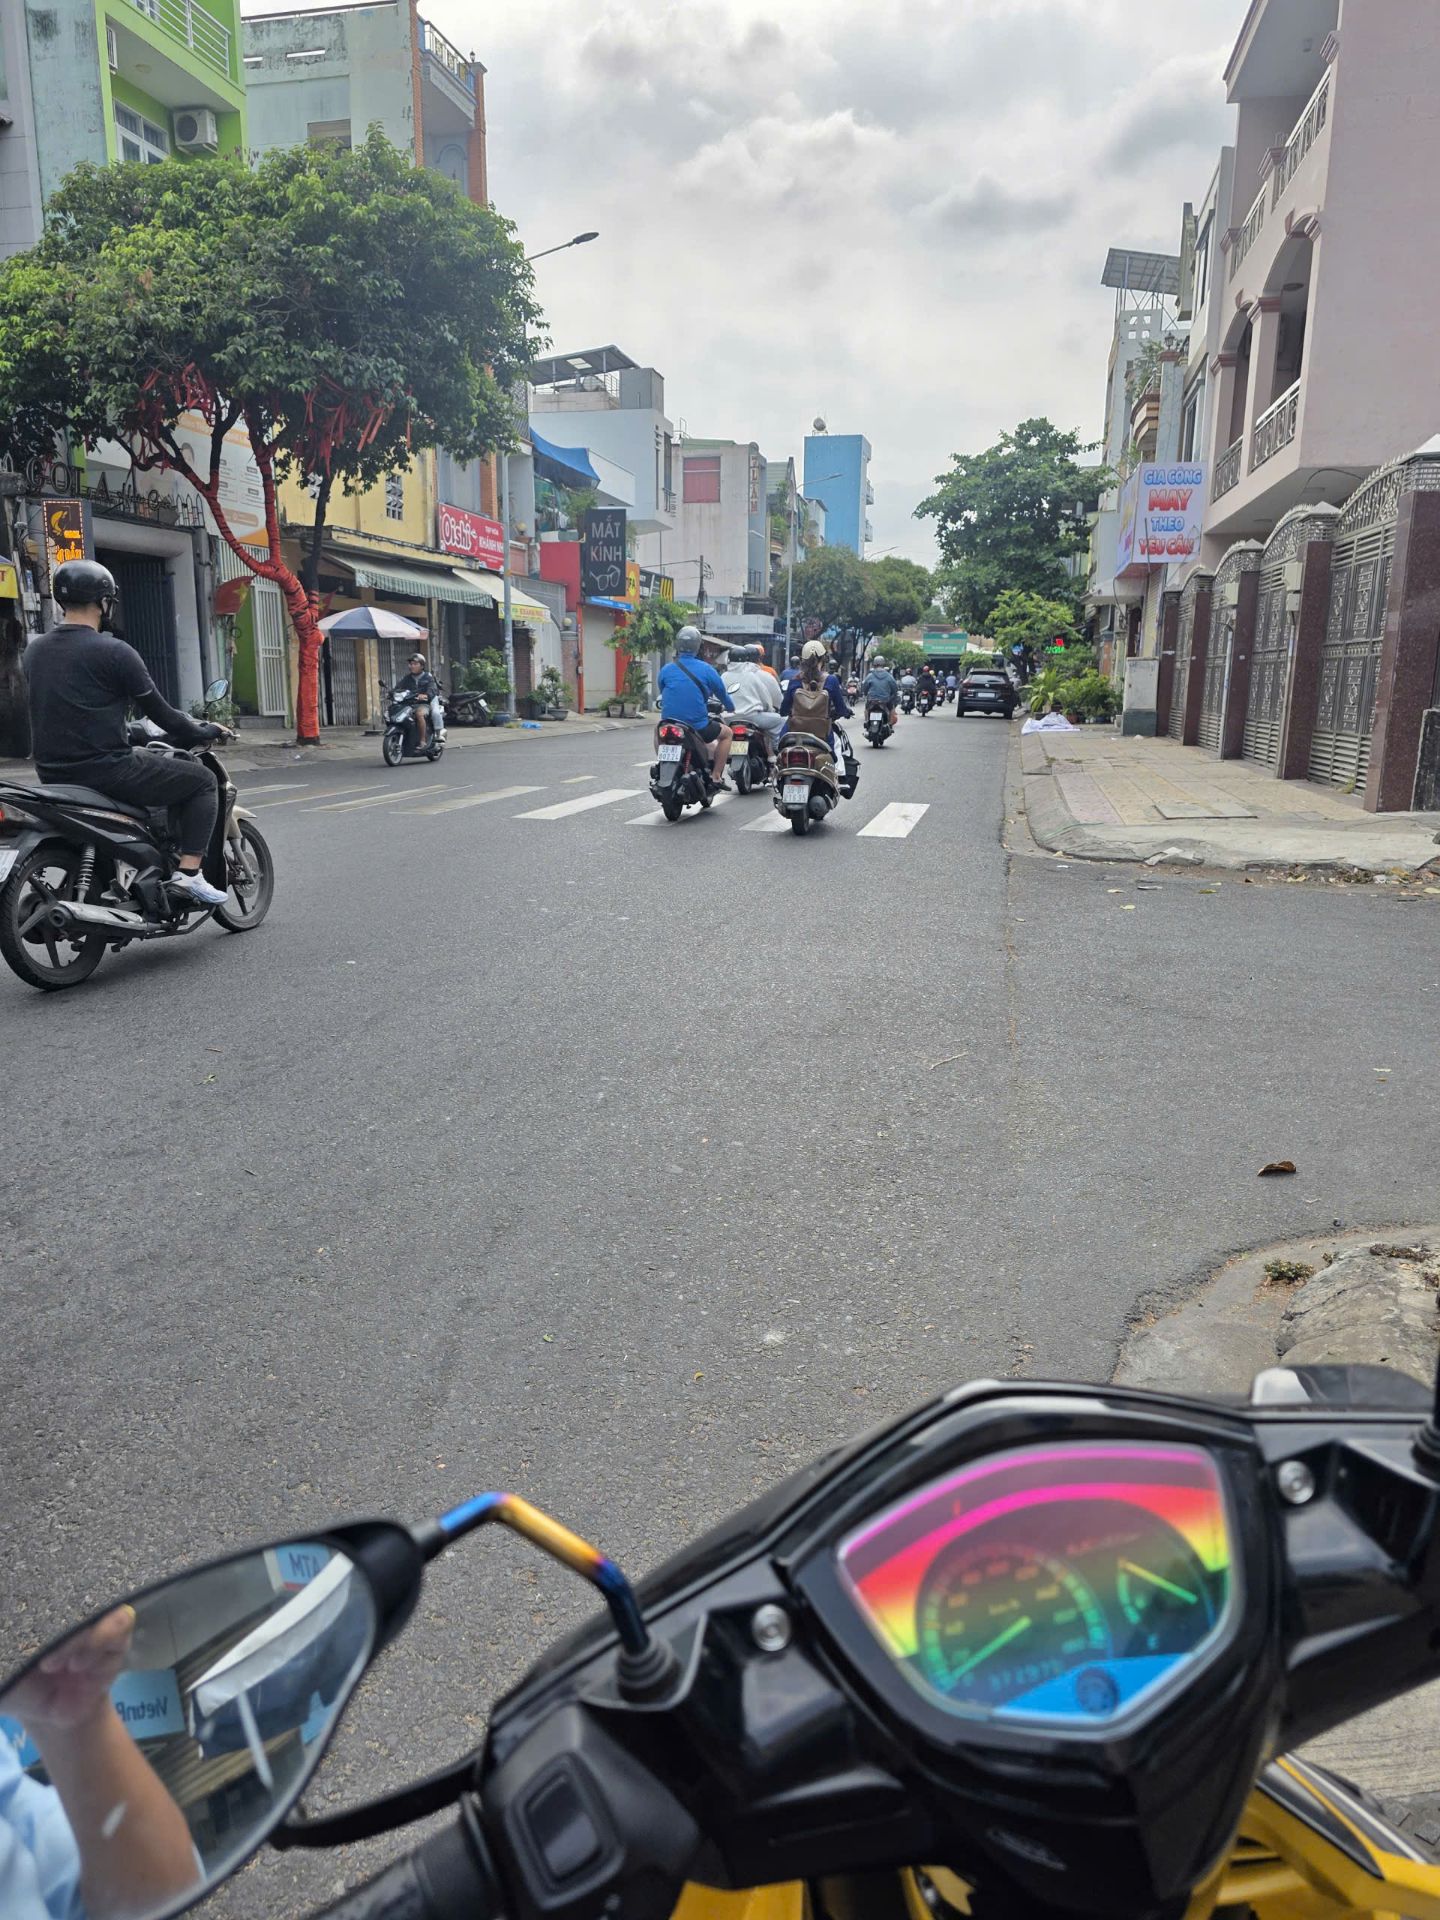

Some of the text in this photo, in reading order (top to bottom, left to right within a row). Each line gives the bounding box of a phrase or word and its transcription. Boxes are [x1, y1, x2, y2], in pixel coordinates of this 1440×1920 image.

[1144, 466, 1202, 486] GIA CÔNG
[1148, 488, 1193, 511] MAY
[442, 513, 472, 551] Oishi
[591, 514, 621, 539] MẮT
[1151, 516, 1184, 532] THEO
[590, 541, 622, 561] KÍNH
